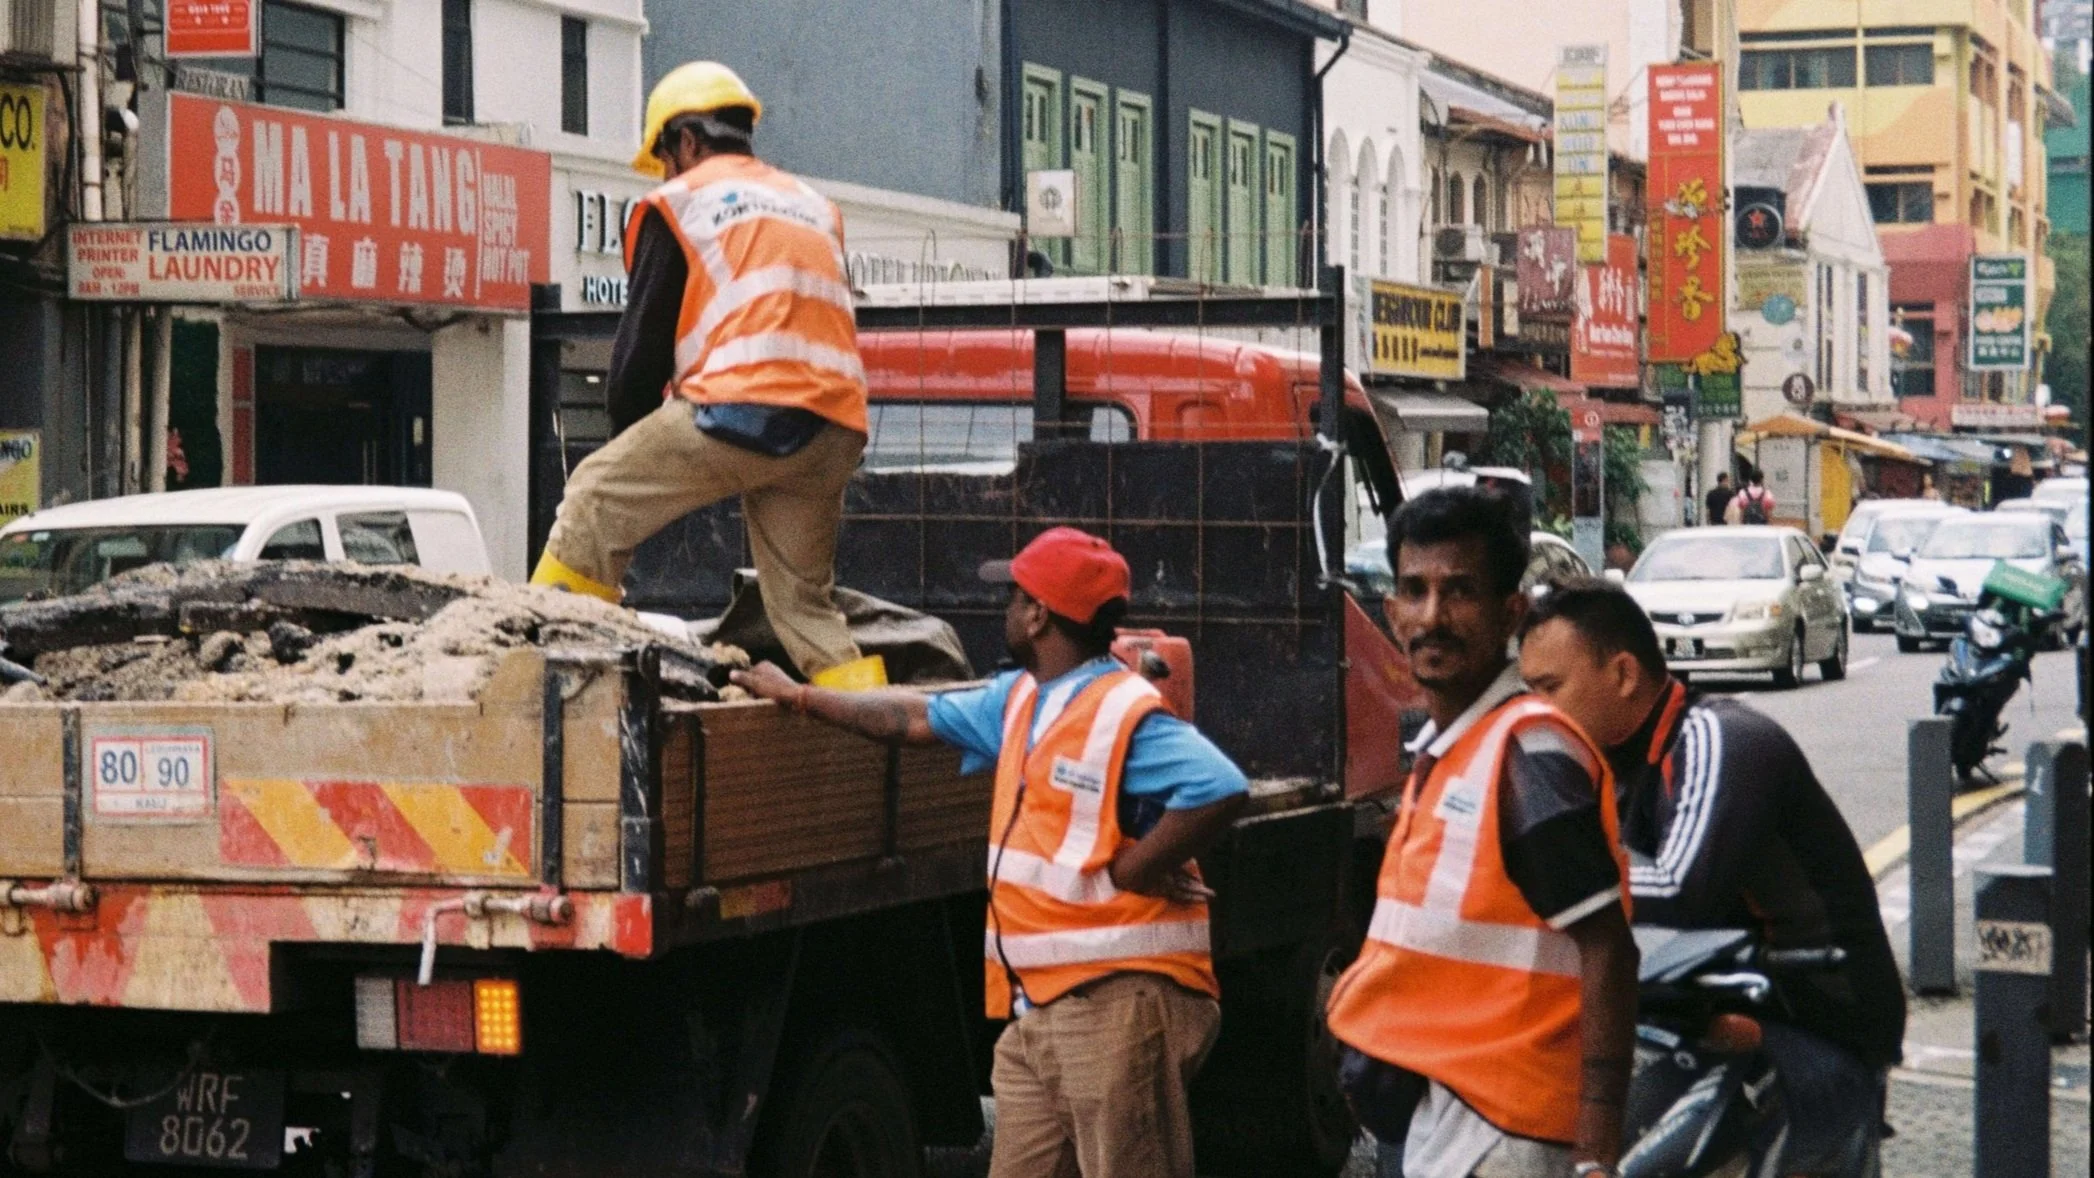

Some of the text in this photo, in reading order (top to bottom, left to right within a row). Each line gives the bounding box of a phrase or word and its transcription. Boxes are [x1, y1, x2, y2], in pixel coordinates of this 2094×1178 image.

[1, 93, 35, 149] CO.
[253, 120, 476, 236] MA LA TANG
[72, 231, 142, 245] INTERNET
[148, 230, 271, 252] FLAMINGO
[77, 249, 139, 262] PRINTER
[149, 255, 279, 282] LAUNDRY
[483, 247, 530, 284] HOT POT
[233, 285, 280, 298] SERVICE
[101, 750, 138, 784] 80
[158, 756, 189, 787] 90
[177, 1073, 243, 1114] WRF
[159, 1115, 250, 1159] 8062
